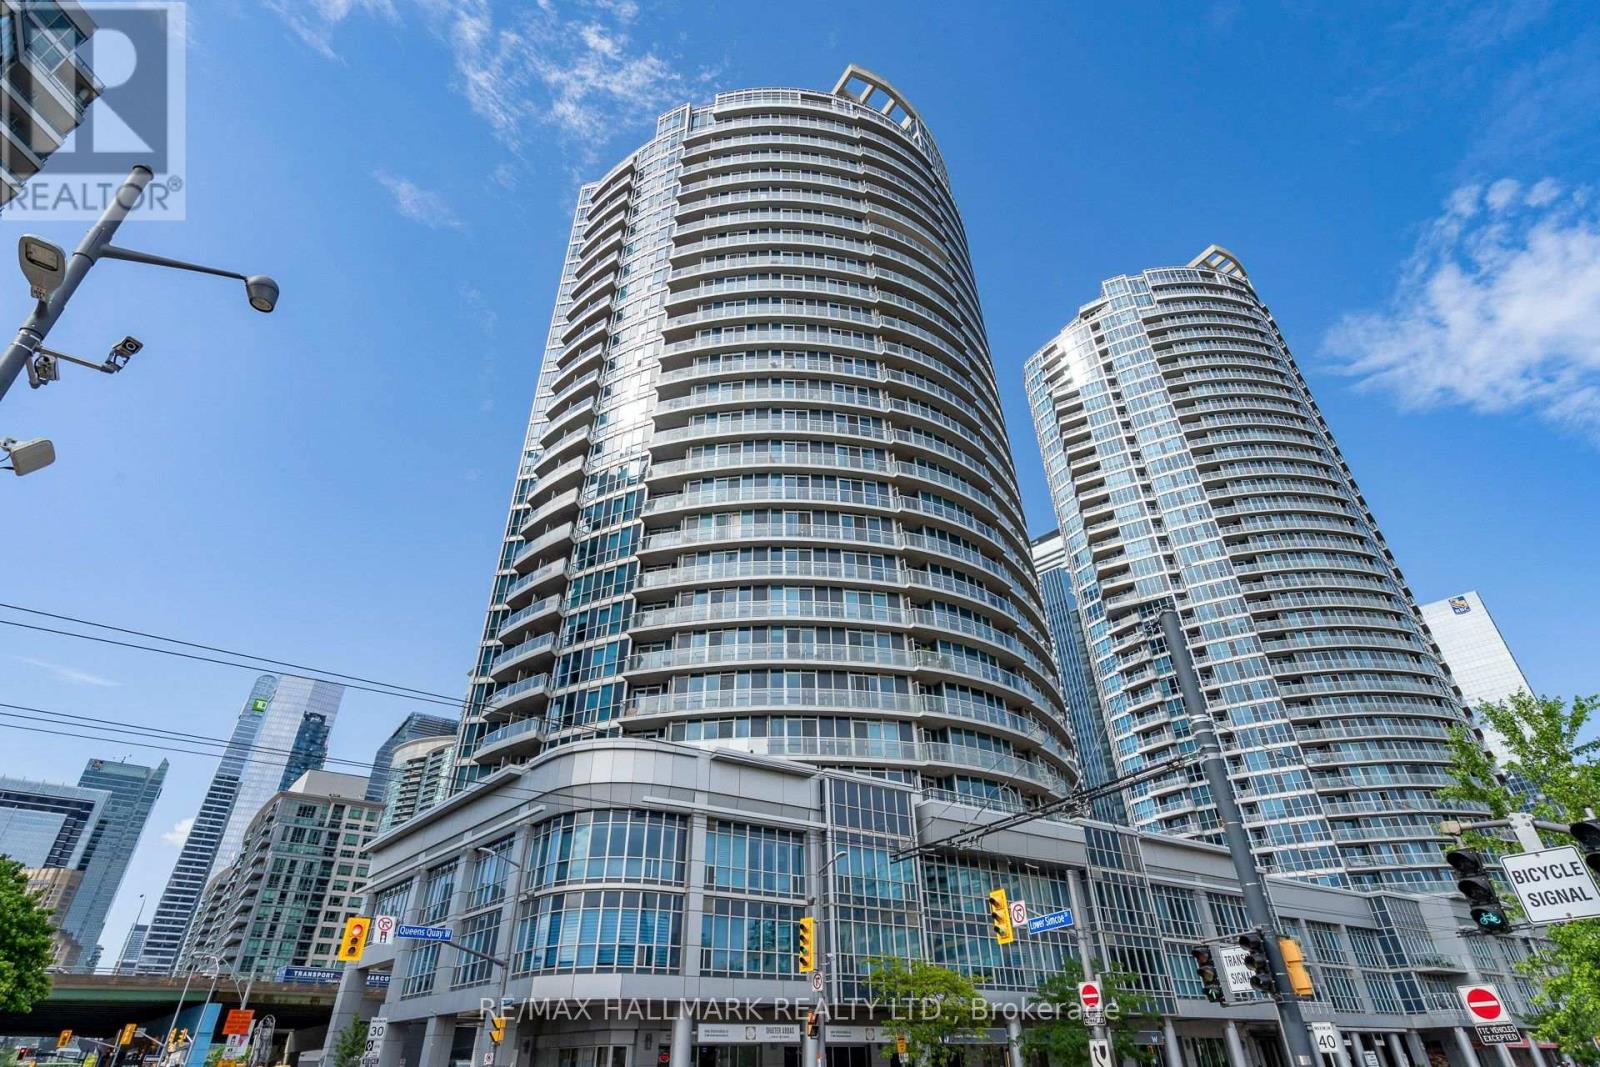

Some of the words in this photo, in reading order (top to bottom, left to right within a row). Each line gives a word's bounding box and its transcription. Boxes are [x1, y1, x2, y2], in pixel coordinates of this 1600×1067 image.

[1511, 861, 1584, 885] BICYCLE
[1527, 886, 1593, 907] SIGNAL
[1030, 919, 1045, 930] Lower
[1045, 914, 1065, 926] Simcoe
[400, 926, 425, 936] Queens
[426, 928, 443, 939] Quay
[1224, 952, 1250, 967] TRANS
[294, 970, 335, 979] TRANSPORT
[370, 1026, 384, 1037] 30
[1491, 1025, 1517, 1034] VEHICLES
[1319, 1034, 1336, 1049] 40
[1483, 1034, 1519, 1042] EXCEPTED
